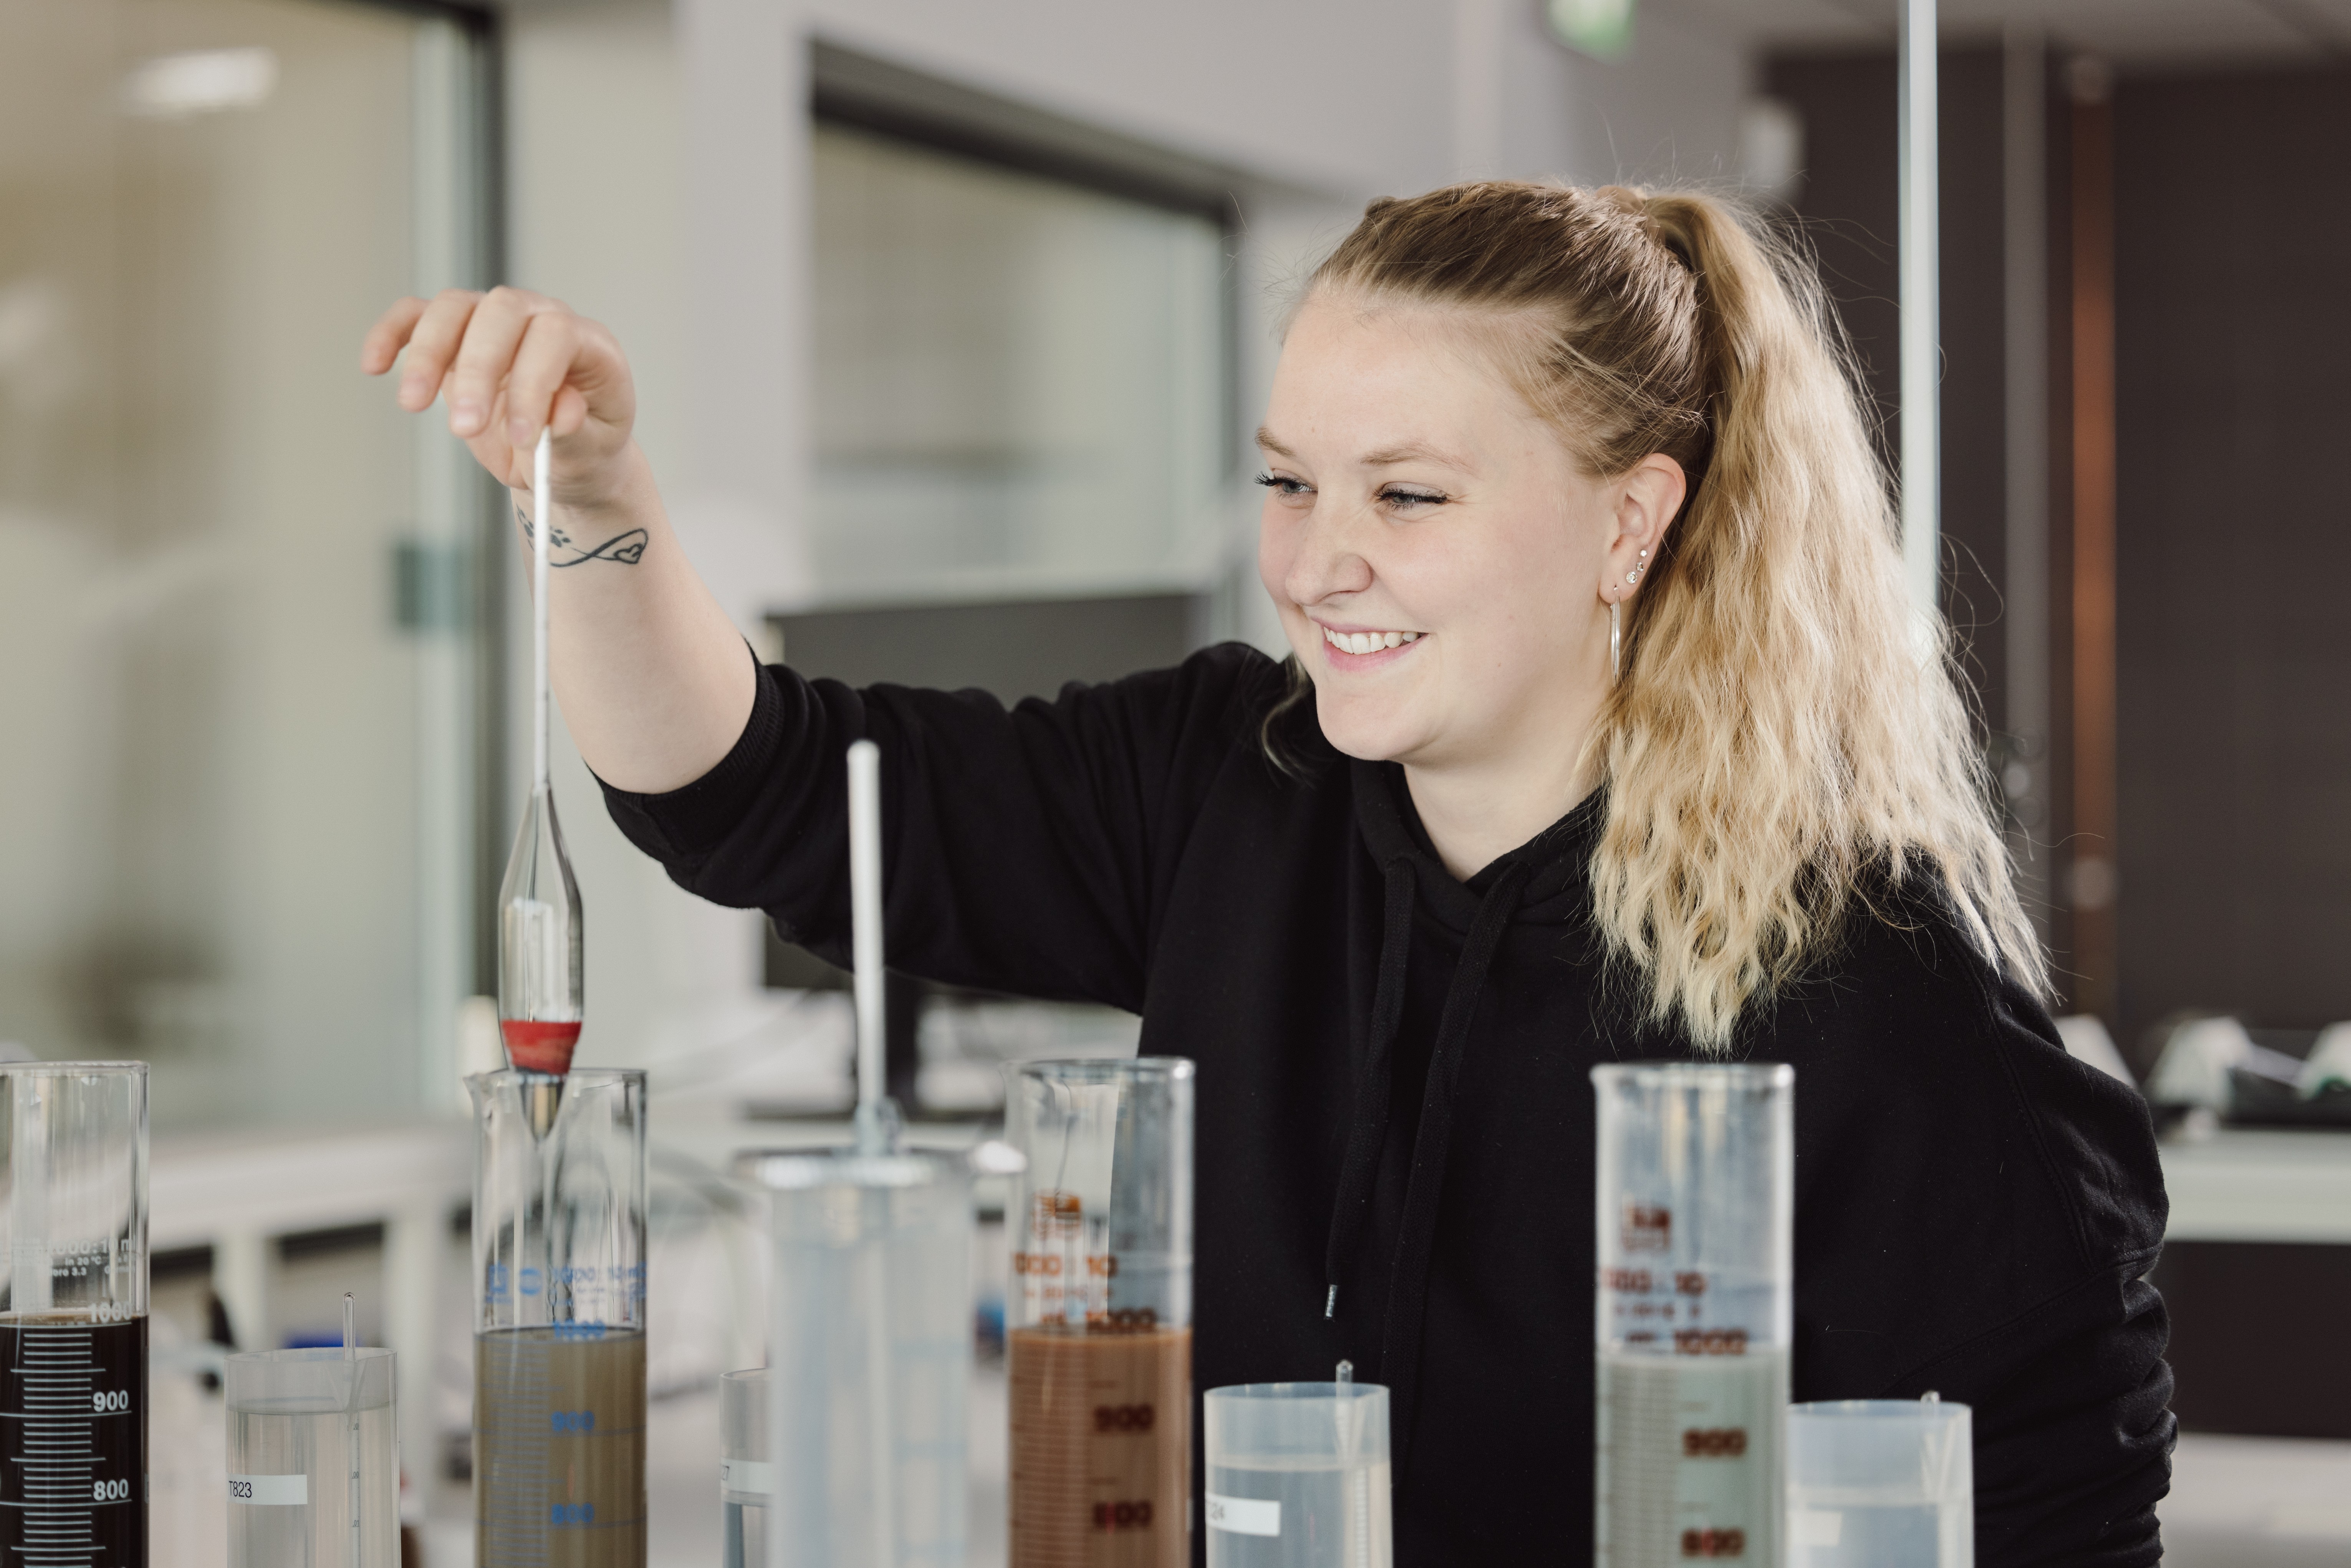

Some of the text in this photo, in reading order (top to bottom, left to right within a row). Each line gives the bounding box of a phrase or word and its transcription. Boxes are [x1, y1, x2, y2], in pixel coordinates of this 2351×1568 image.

[71, 1267, 87, 1276] 3.3
[77, 1256, 89, 1266] 20
[89, 1302, 132, 1323] 1000
[93, 1390, 129, 1412] 900
[550, 1410, 595, 1432] 900
[93, 1479, 129, 1502] 800
[228, 1480, 252, 1498] T823
